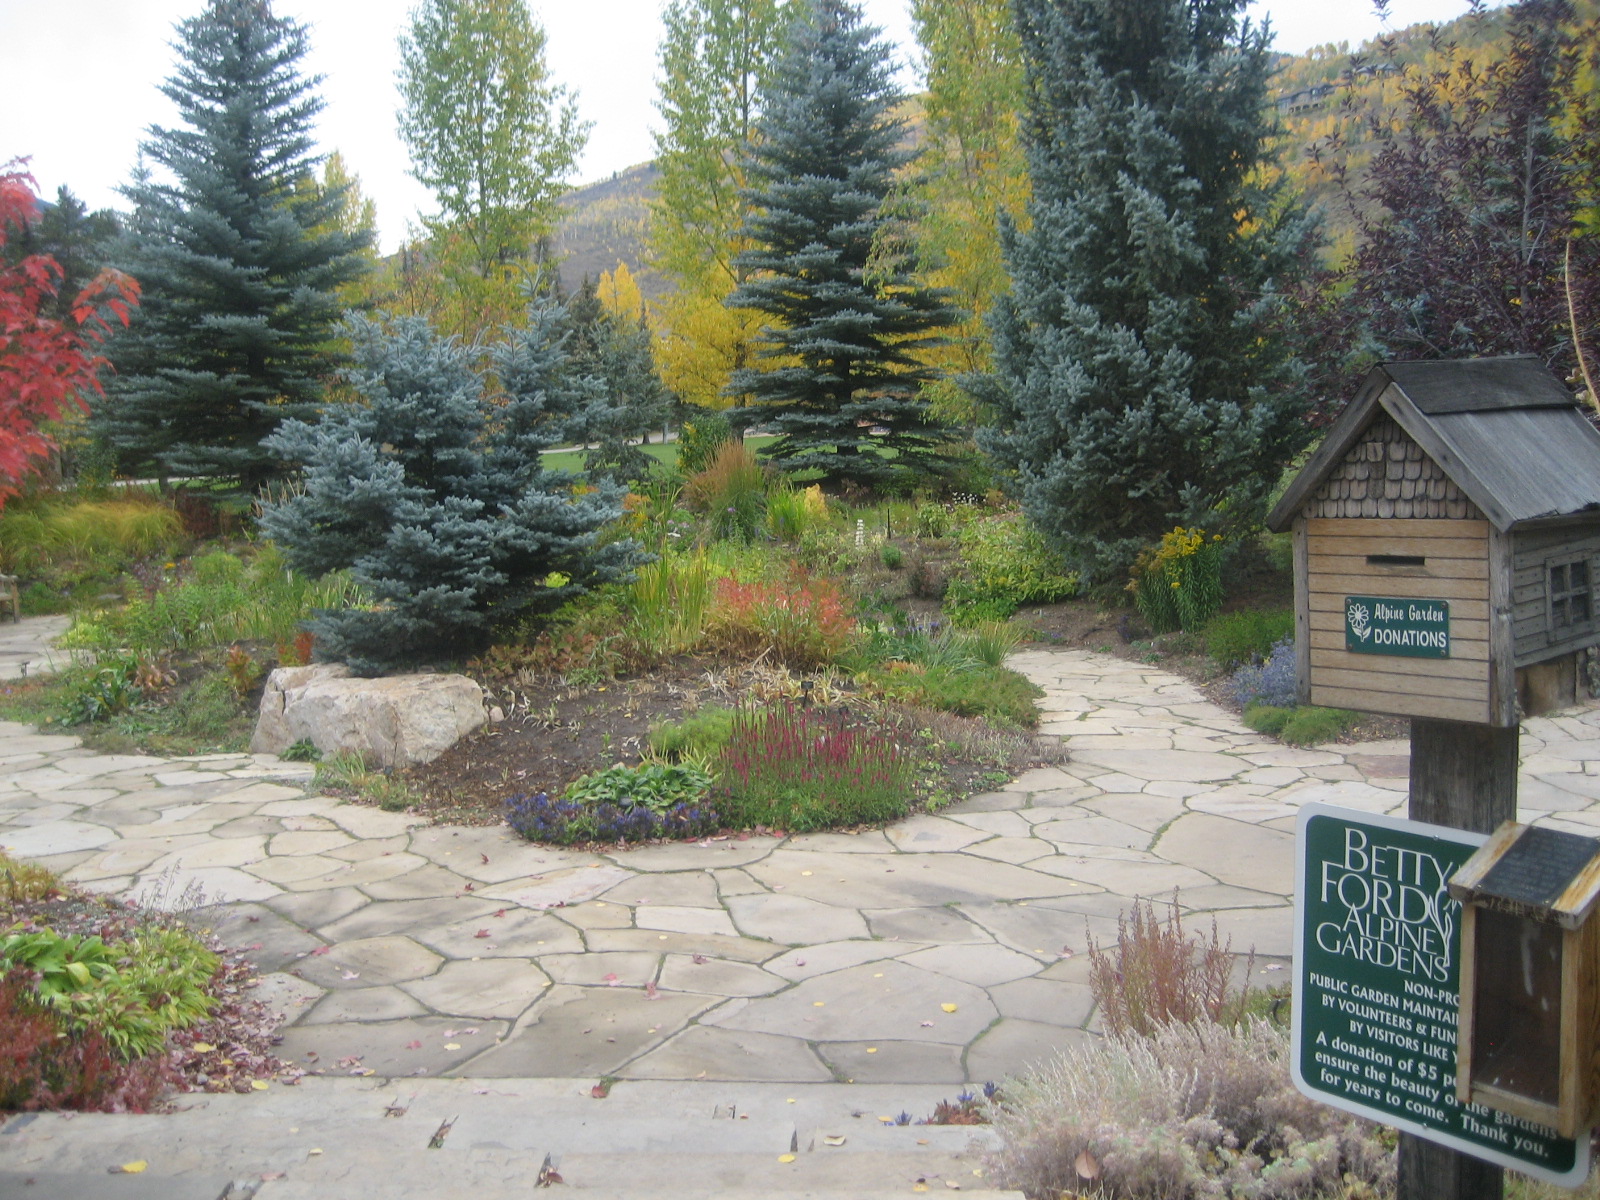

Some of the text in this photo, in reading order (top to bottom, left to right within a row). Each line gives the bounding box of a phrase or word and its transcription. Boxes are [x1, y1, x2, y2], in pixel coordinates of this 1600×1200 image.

[1374, 603, 1443, 623] Alpine Garden
[1374, 629, 1447, 647] DONATIONS
[1344, 827, 1453, 888] BETTY
[1321, 860, 1429, 924] FORD
[1316, 922, 1448, 982] GARDENS
[1343, 902, 1437, 955] ALPINE
[1309, 972, 1459, 1026] PUBLIC GARDEN MAINTAI
[1322, 994, 1459, 1045] BY VOLUNTEERS & FUN
[1316, 1031, 1327, 1046] A
[1332, 1036, 1393, 1067] donation
[1398, 1059, 1414, 1073] of
[1418, 1062, 1438, 1081] $5
[1350, 1020, 1363, 1034] BY
[1366, 1025, 1419, 1051] VISITORS
[1423, 1043, 1448, 1061] LIKE
[1315, 1051, 1359, 1074] ensure
[1364, 1066, 1386, 1083] the
[1391, 1072, 1440, 1102] beauty
[1321, 1068, 1549, 1157] for years to come. Thank you.
